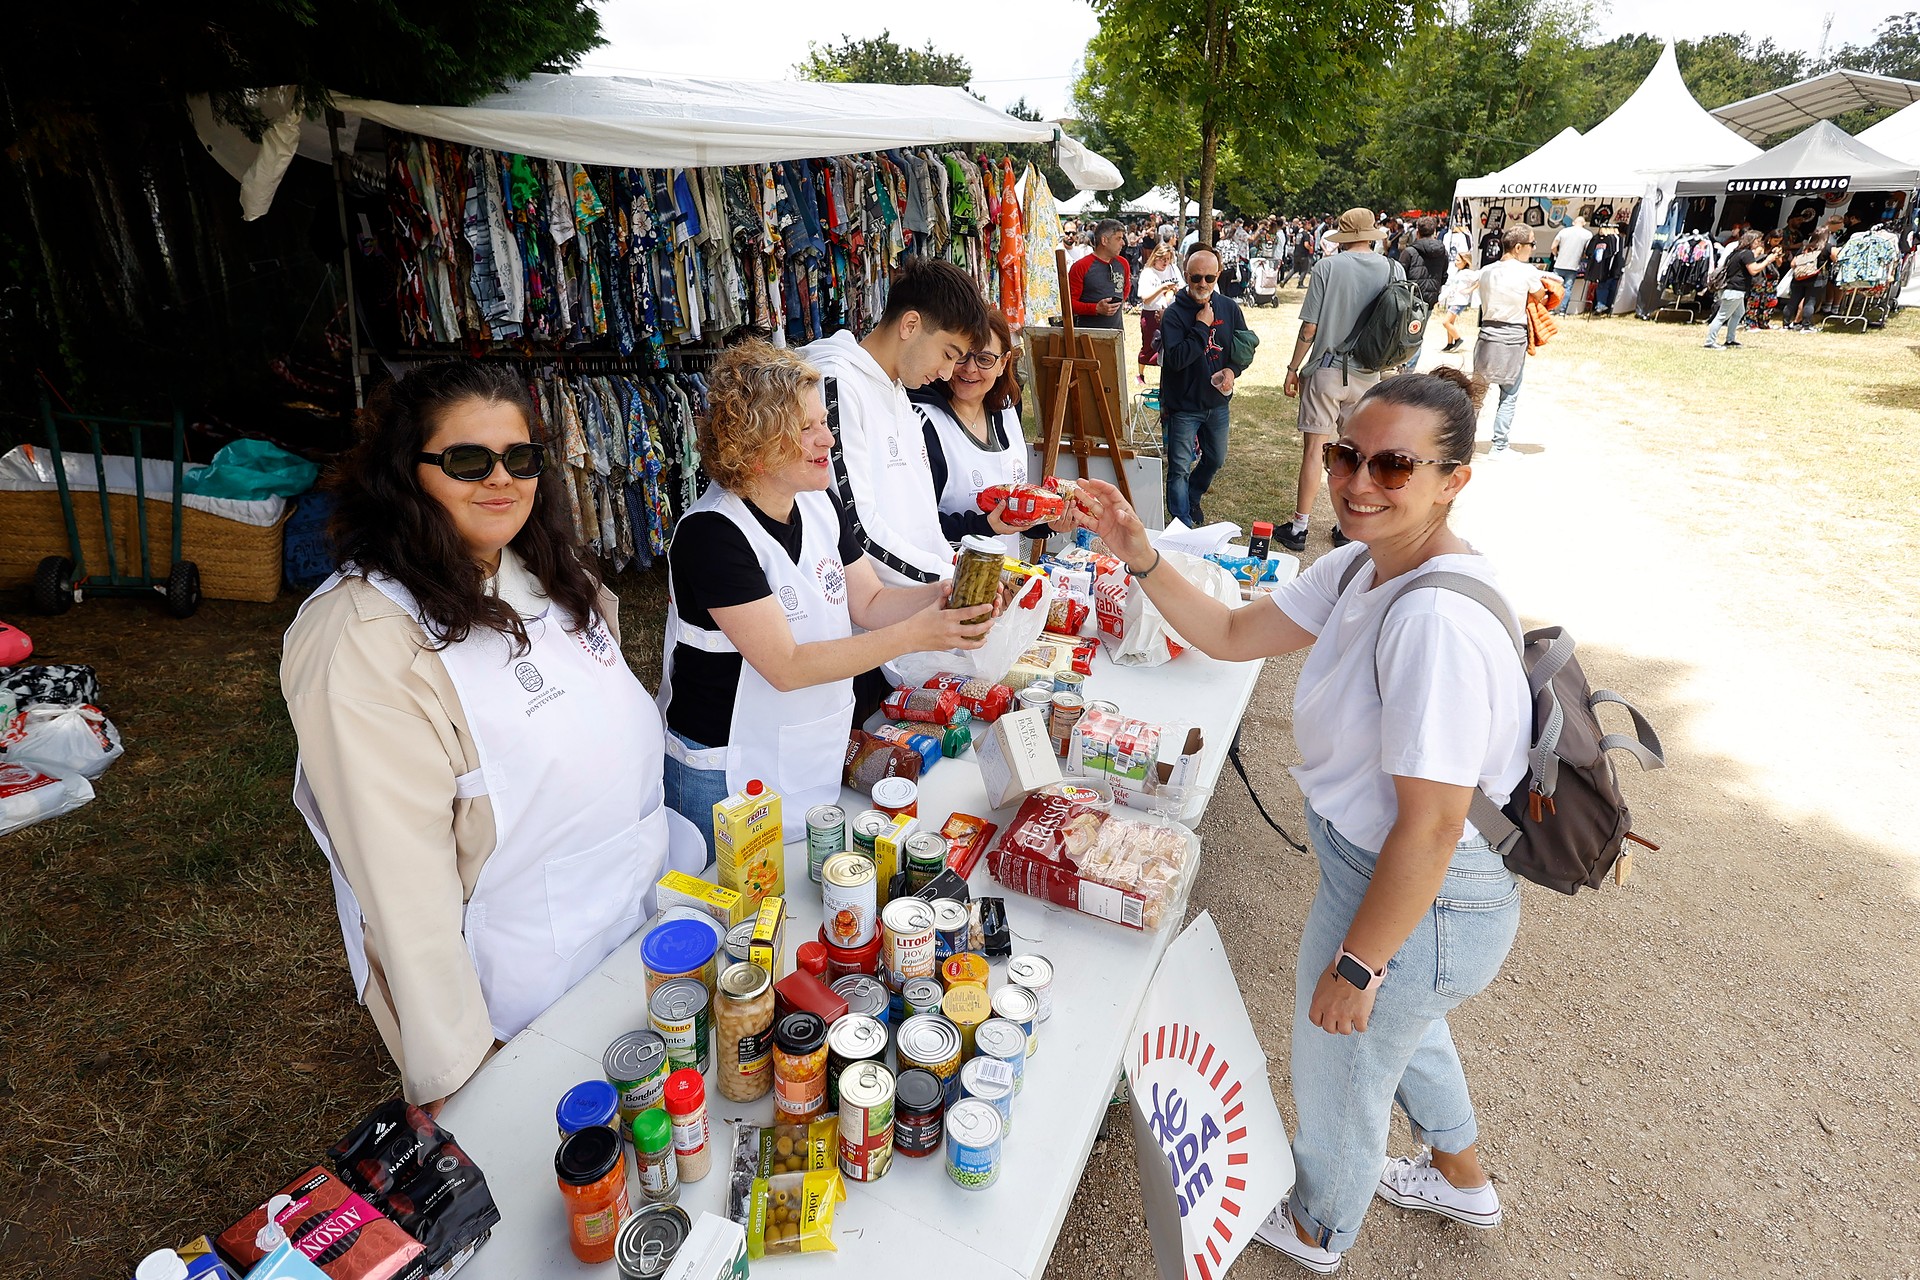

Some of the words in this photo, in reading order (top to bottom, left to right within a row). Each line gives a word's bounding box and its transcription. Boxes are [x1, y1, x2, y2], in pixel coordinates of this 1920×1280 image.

[1499, 183, 1597, 194] ACONTRAVENTO
[1727, 180, 1786, 191] CULEBRA
[1794, 178, 1848, 190] STUDIO
[1018, 718, 1036, 759] BATATAS
[845, 742, 861, 766] LENTEJA
[748, 807, 767, 823] FROIZ
[903, 949, 924, 958] HOY
[671, 1022, 691, 1032] EBRO
[625, 1078, 665, 1102] Bonduell
[388, 1140, 425, 1174] NATURAL
[815, 1137, 826, 1169] Jolca
[808, 1192, 819, 1223] Jolca
[299, 1206, 361, 1261] AUSONI
